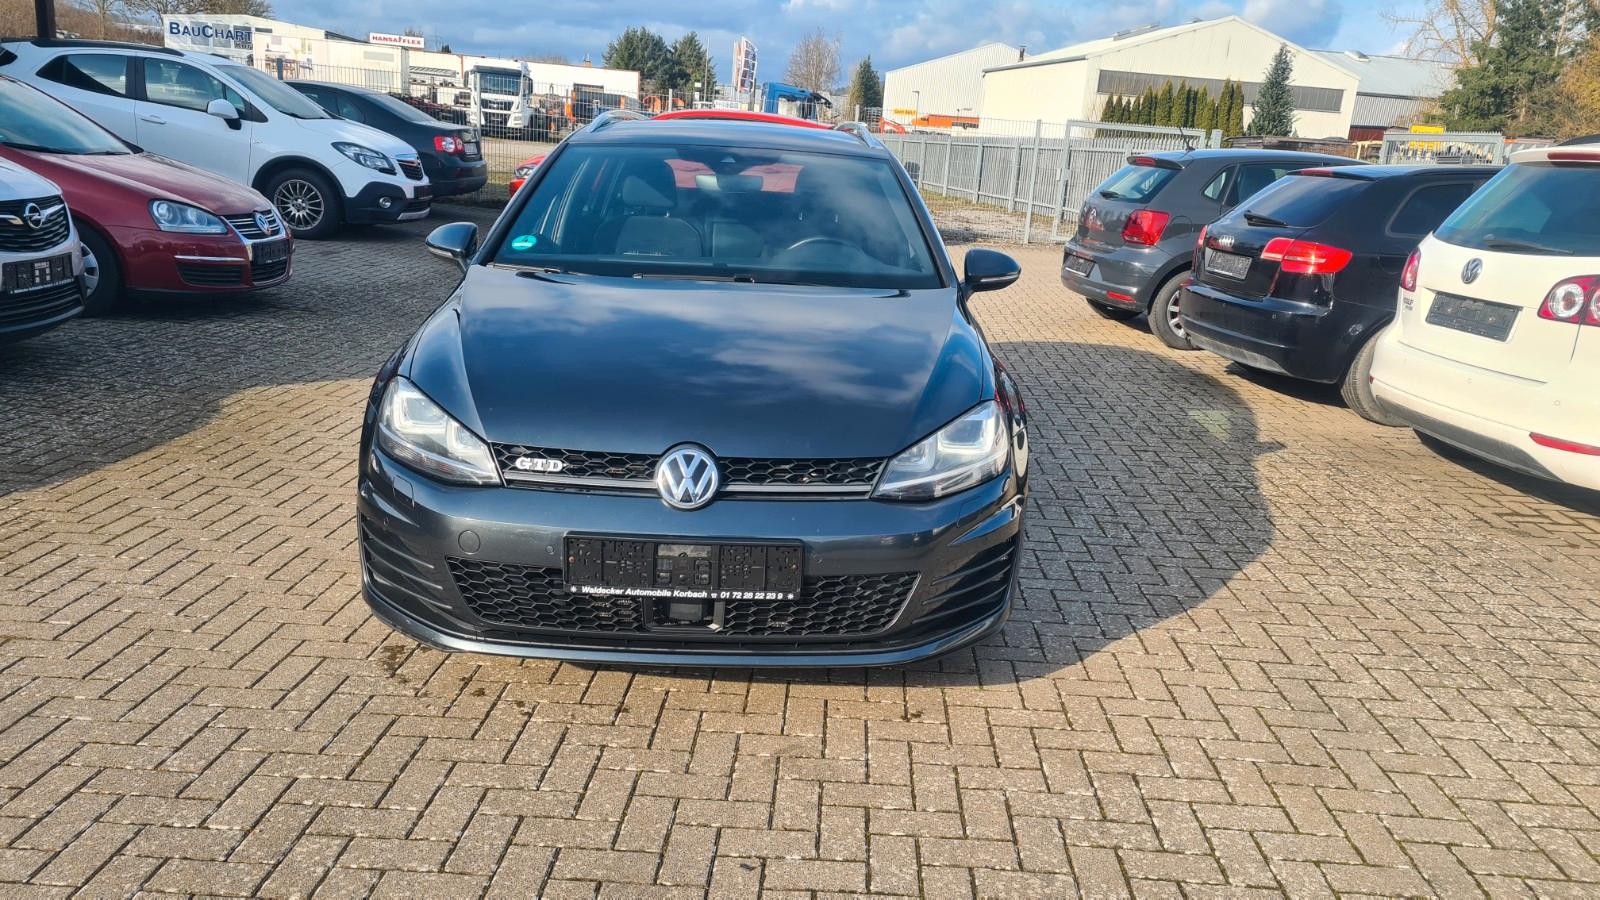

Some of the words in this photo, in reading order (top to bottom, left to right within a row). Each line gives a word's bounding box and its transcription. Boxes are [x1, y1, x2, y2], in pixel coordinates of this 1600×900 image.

[515, 456, 563, 472] GTD
[581, 585, 625, 595] Waldecker
[625, 588, 671, 597] Automobile
[673, 590, 708, 598] Korbach
[720, 591, 730, 599] 01
[732, 591, 742, 599] 72
[755, 592, 765, 600] 22
